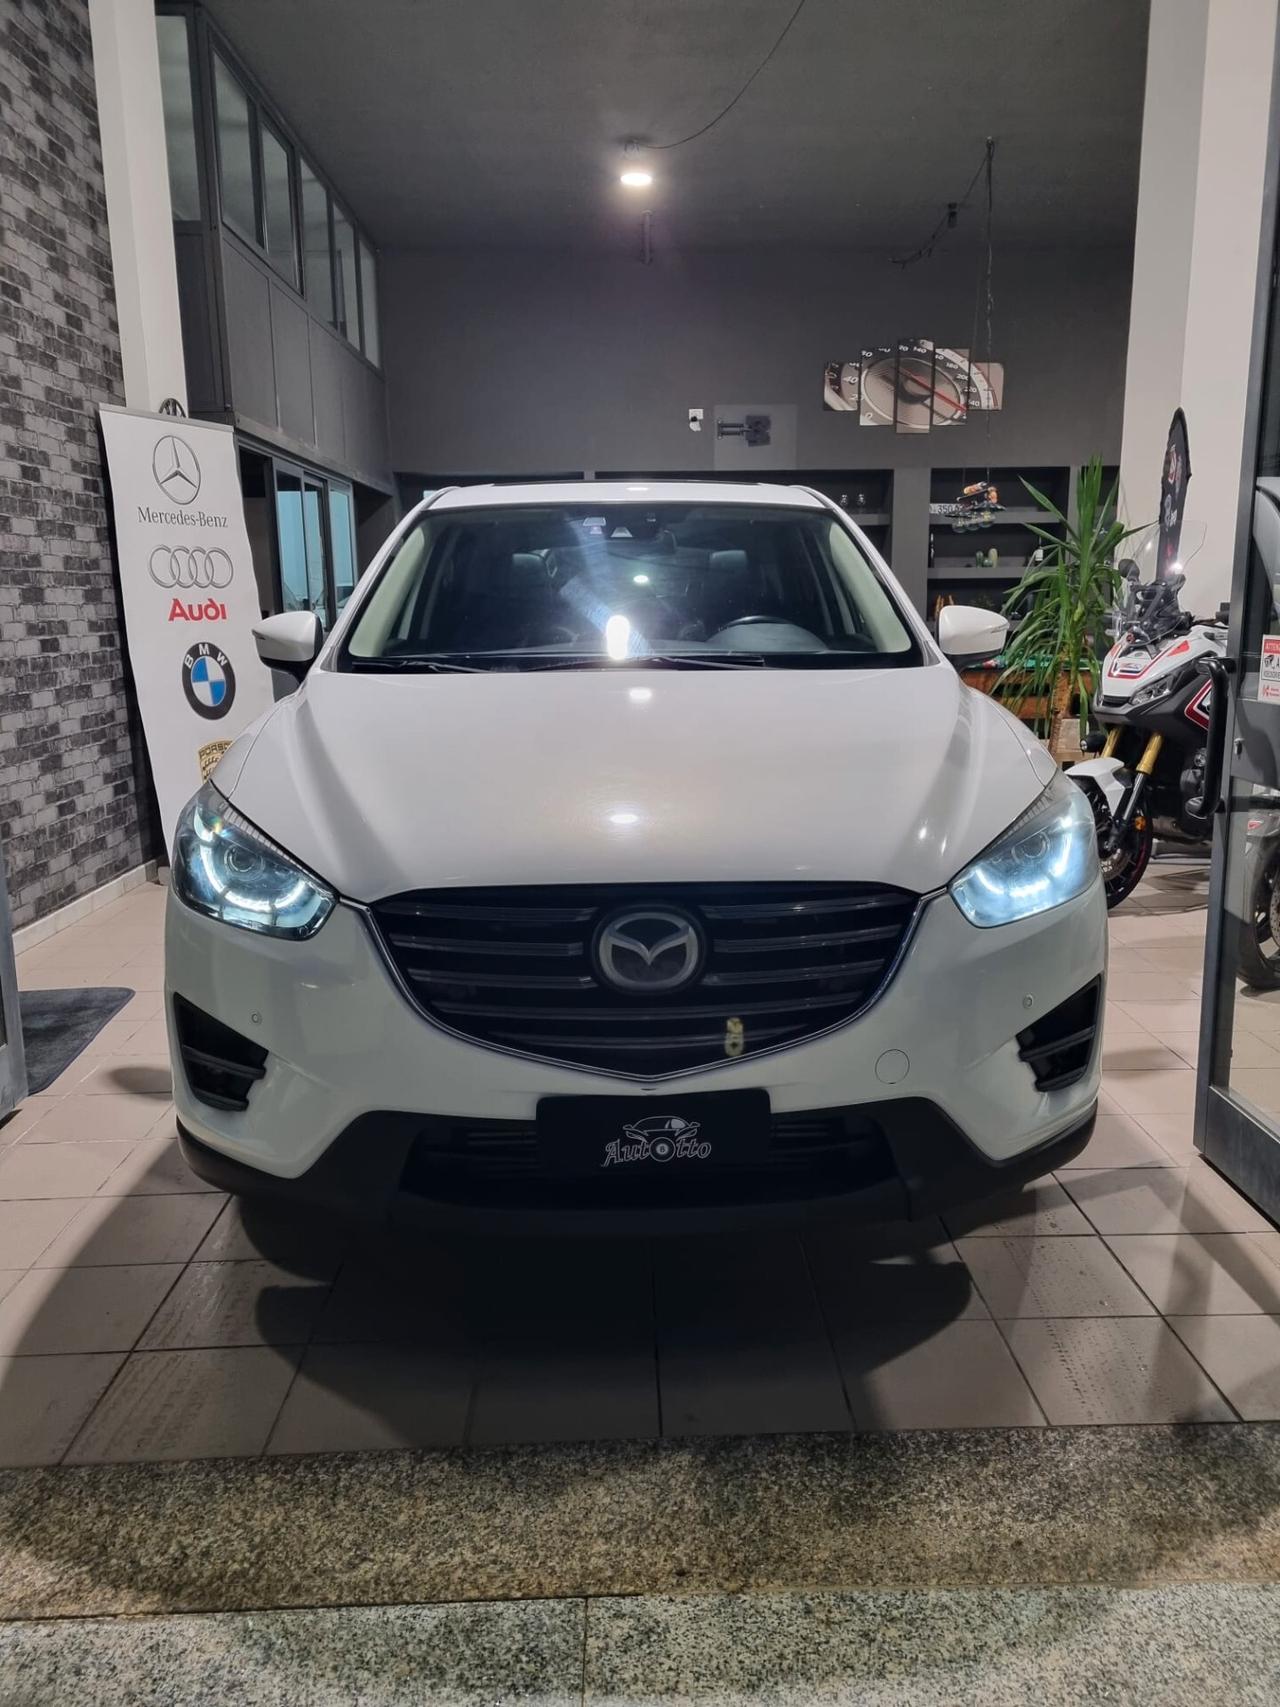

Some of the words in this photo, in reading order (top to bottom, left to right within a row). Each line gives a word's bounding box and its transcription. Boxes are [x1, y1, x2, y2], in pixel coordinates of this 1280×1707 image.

[138, 506, 229, 528] Mercedes-Benz
[168, 598, 228, 622] Audi
[184, 643, 228, 669] BMW
